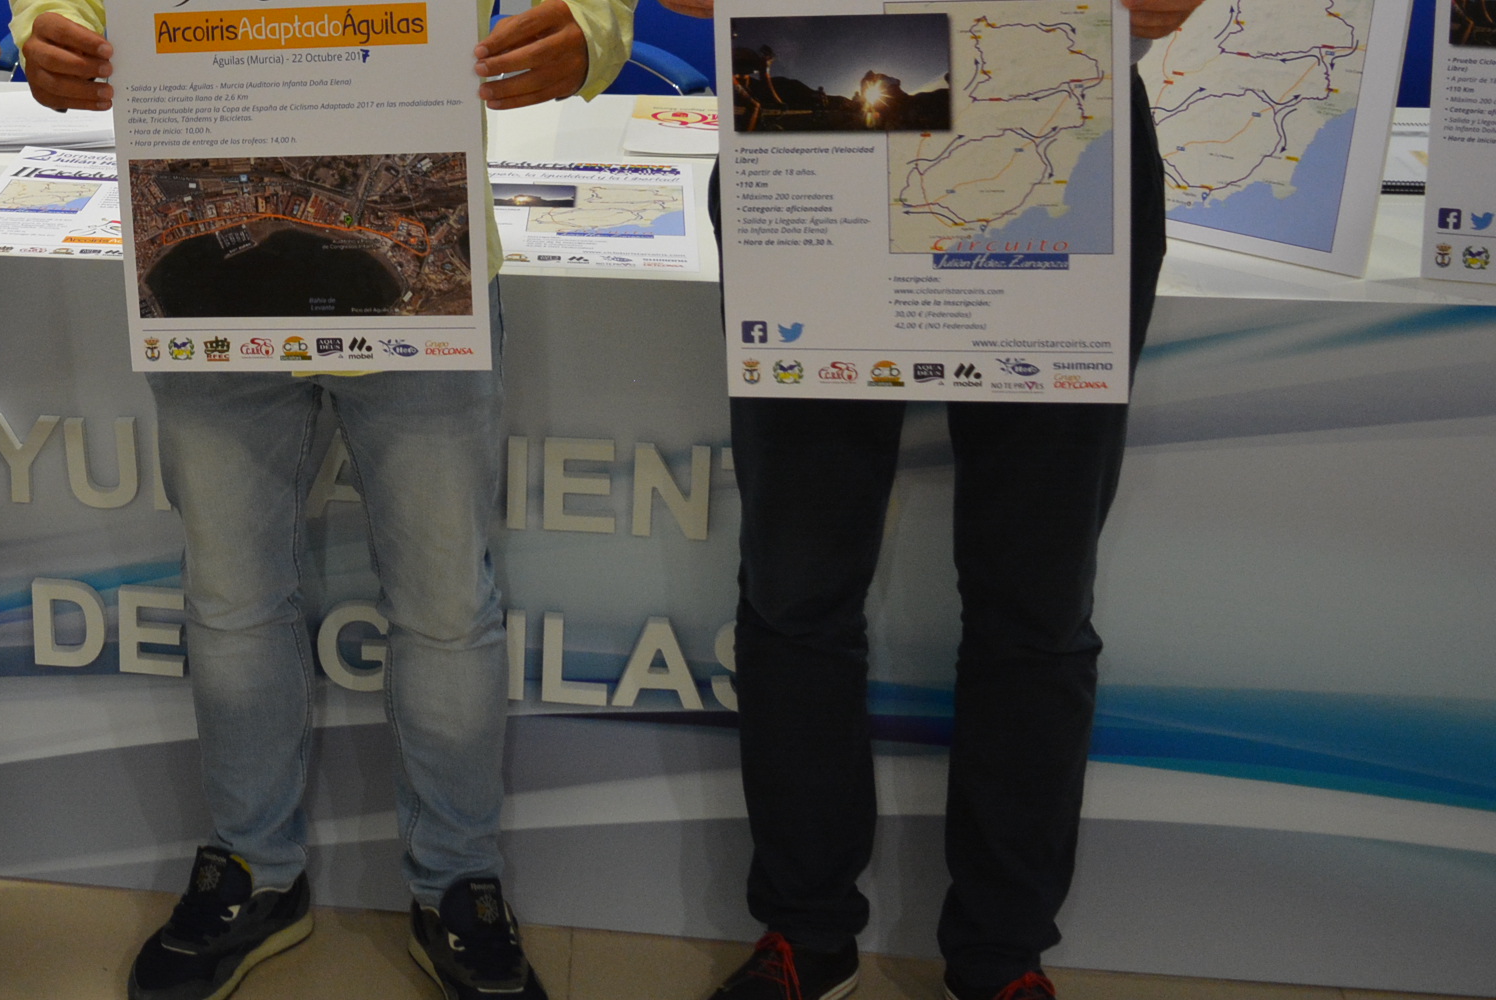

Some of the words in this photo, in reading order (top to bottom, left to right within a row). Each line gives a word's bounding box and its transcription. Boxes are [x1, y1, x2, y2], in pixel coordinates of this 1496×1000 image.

[212, 54, 245, 68] Águilas
[246, 54, 284, 66] (Murcia)
[291, 53, 303, 63] 22
[304, 52, 343, 63] Octubre
[969, 336, 1111, 351] www.cicloturistarcoiris.com
[1052, 361, 1112, 371] SHIMANO
[952, 380, 983, 388] mobel
[31, 577, 185, 676] DE
